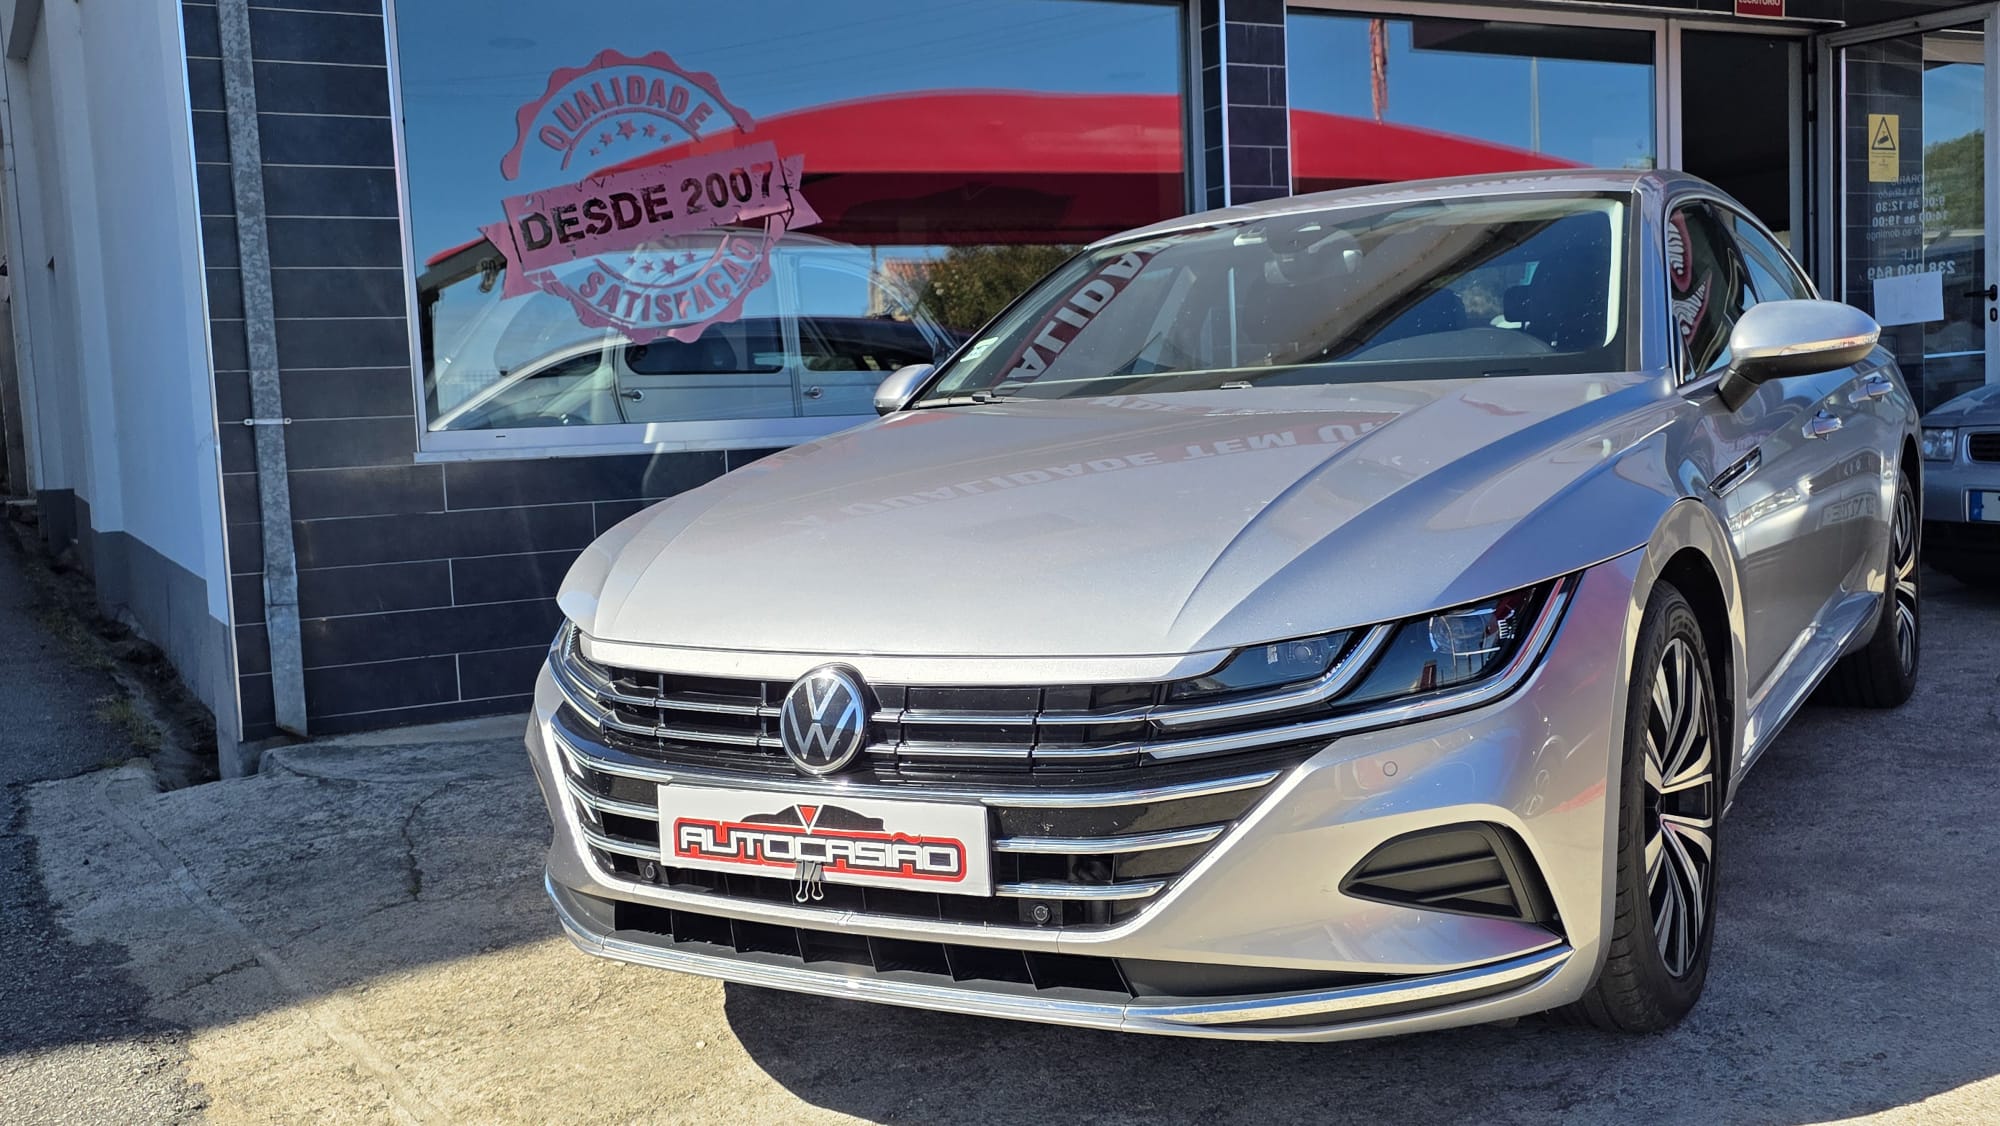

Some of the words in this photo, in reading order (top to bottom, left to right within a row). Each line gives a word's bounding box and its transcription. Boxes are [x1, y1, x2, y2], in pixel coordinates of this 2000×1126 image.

[538, 74, 714, 151] QUALIDADE
[519, 182, 674, 252] DESDE
[680, 160, 775, 215] 2007
